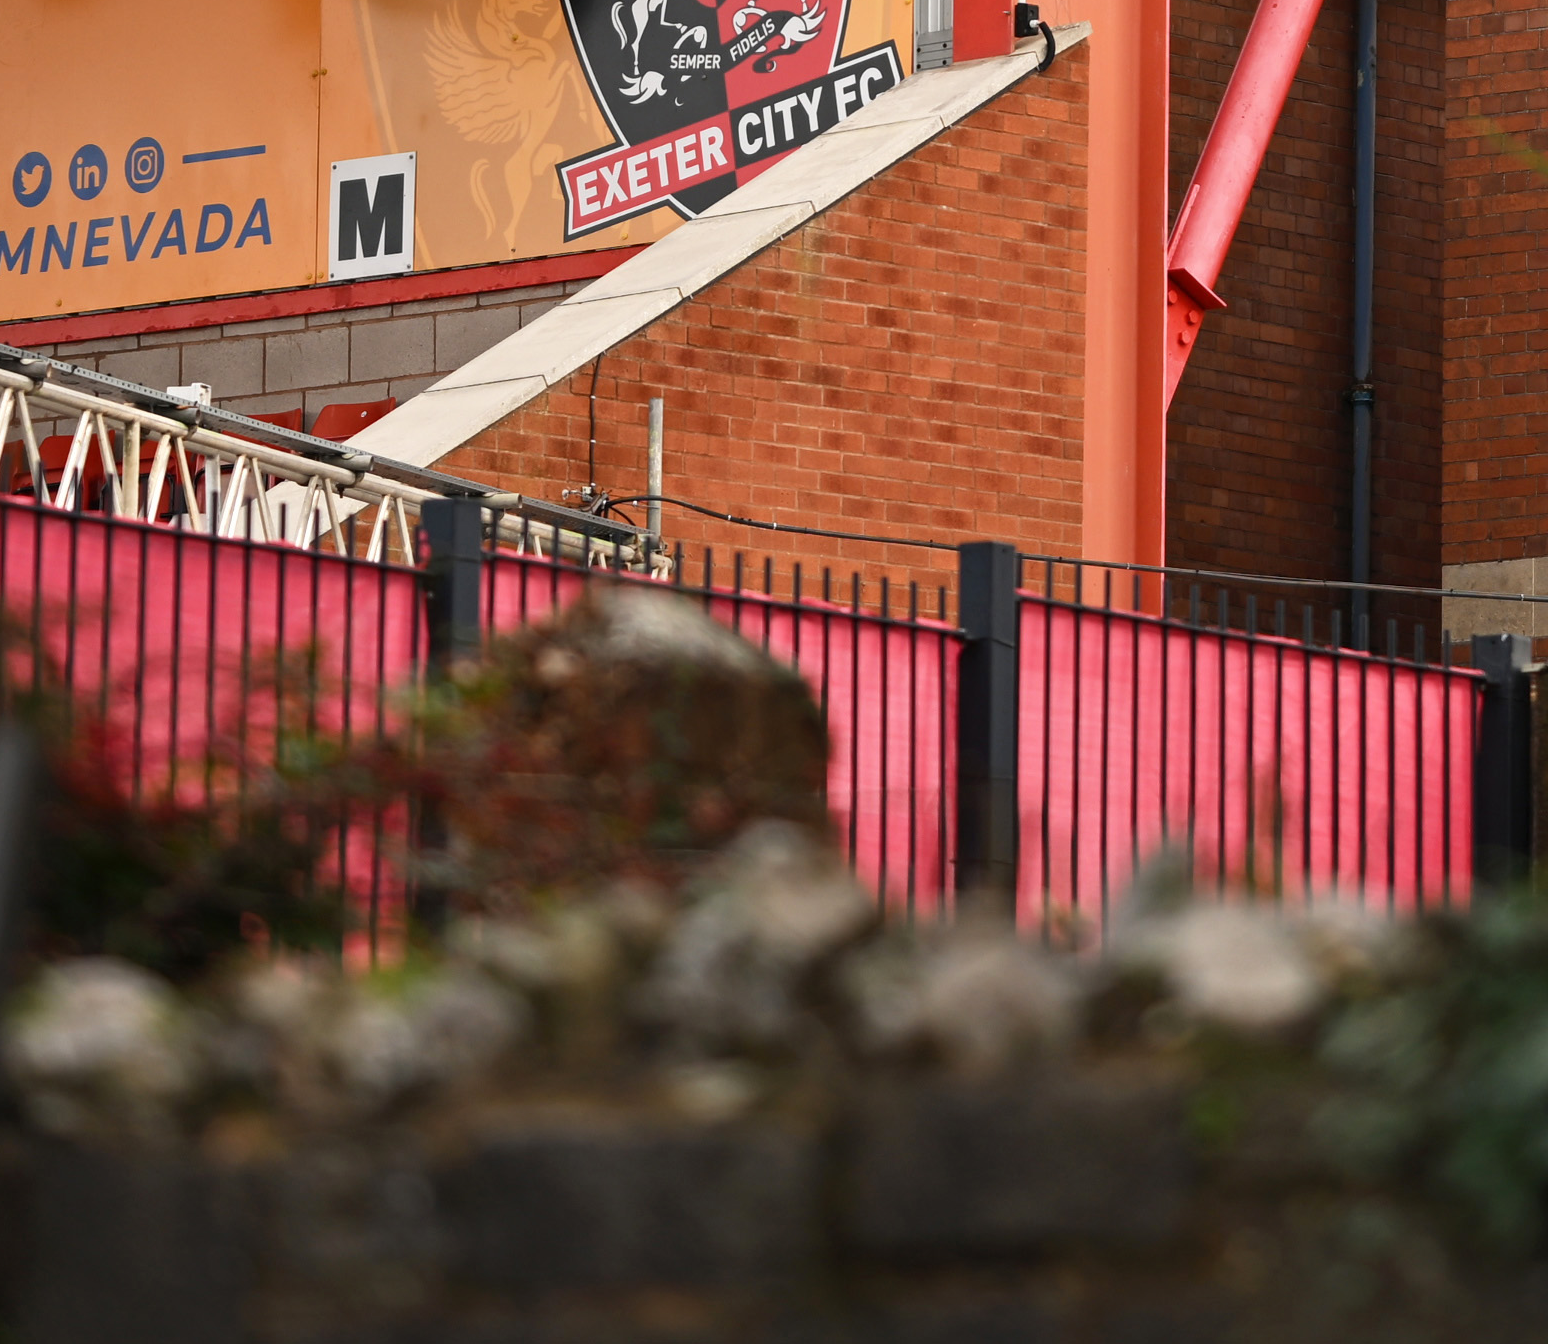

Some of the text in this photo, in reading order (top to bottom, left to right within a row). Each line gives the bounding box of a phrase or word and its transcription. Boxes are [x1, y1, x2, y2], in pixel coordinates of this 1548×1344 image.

[670, 18, 775, 69] SEMPER FIDELIS
[576, 67, 883, 217] EXETER CITY FC
[338, 173, 405, 262] M
